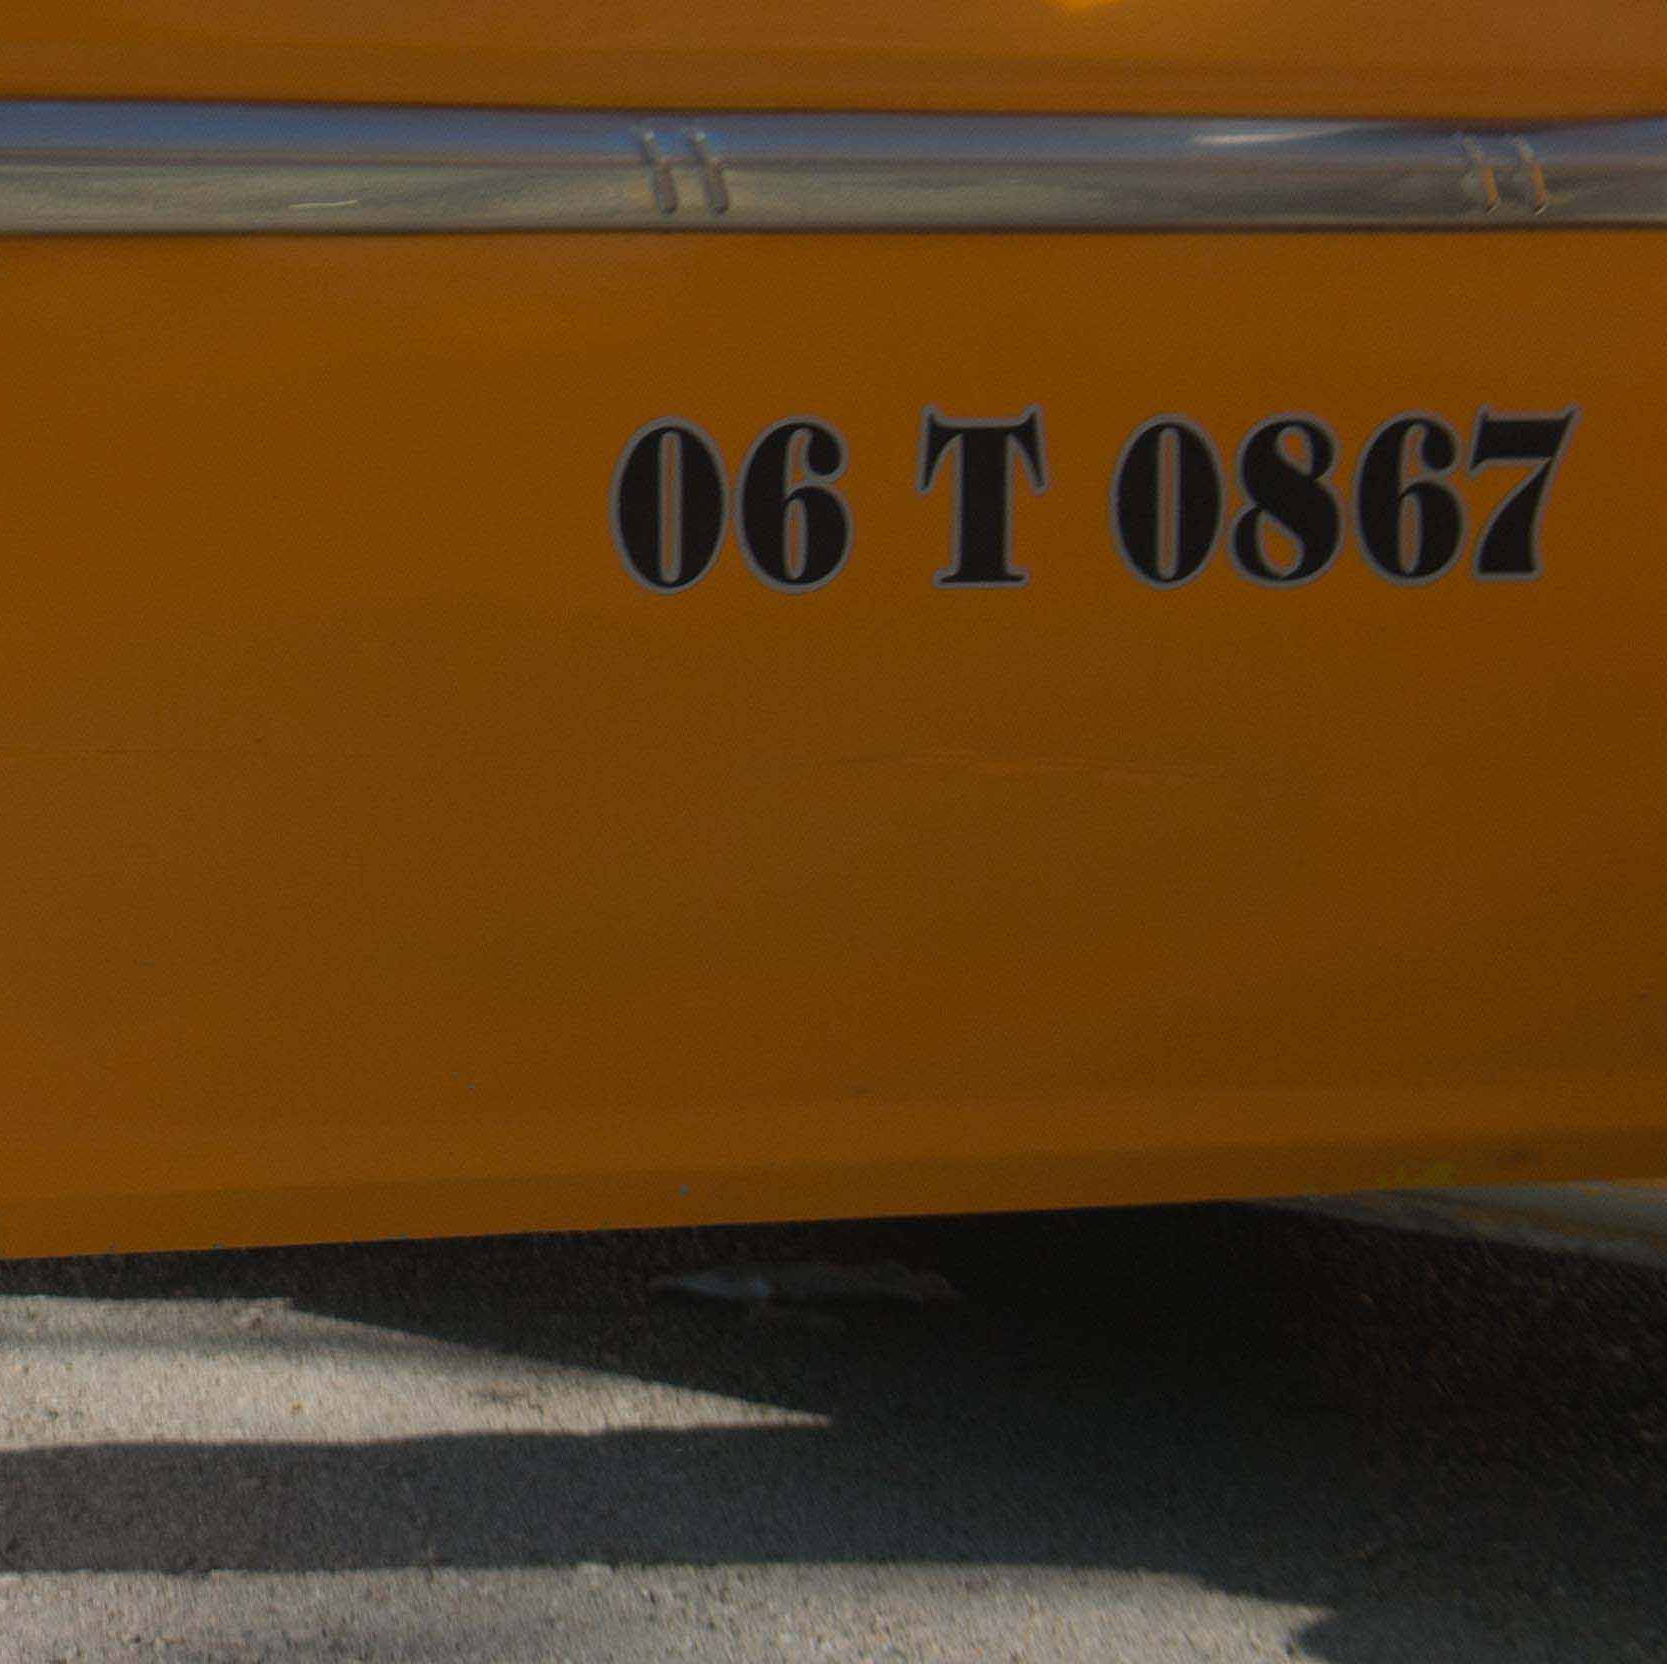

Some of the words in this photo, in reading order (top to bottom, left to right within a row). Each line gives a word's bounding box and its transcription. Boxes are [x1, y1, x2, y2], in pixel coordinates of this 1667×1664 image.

[610, 416, 854, 594] 06
[917, 405, 1048, 588] T
[1110, 407, 1578, 589] 0867
